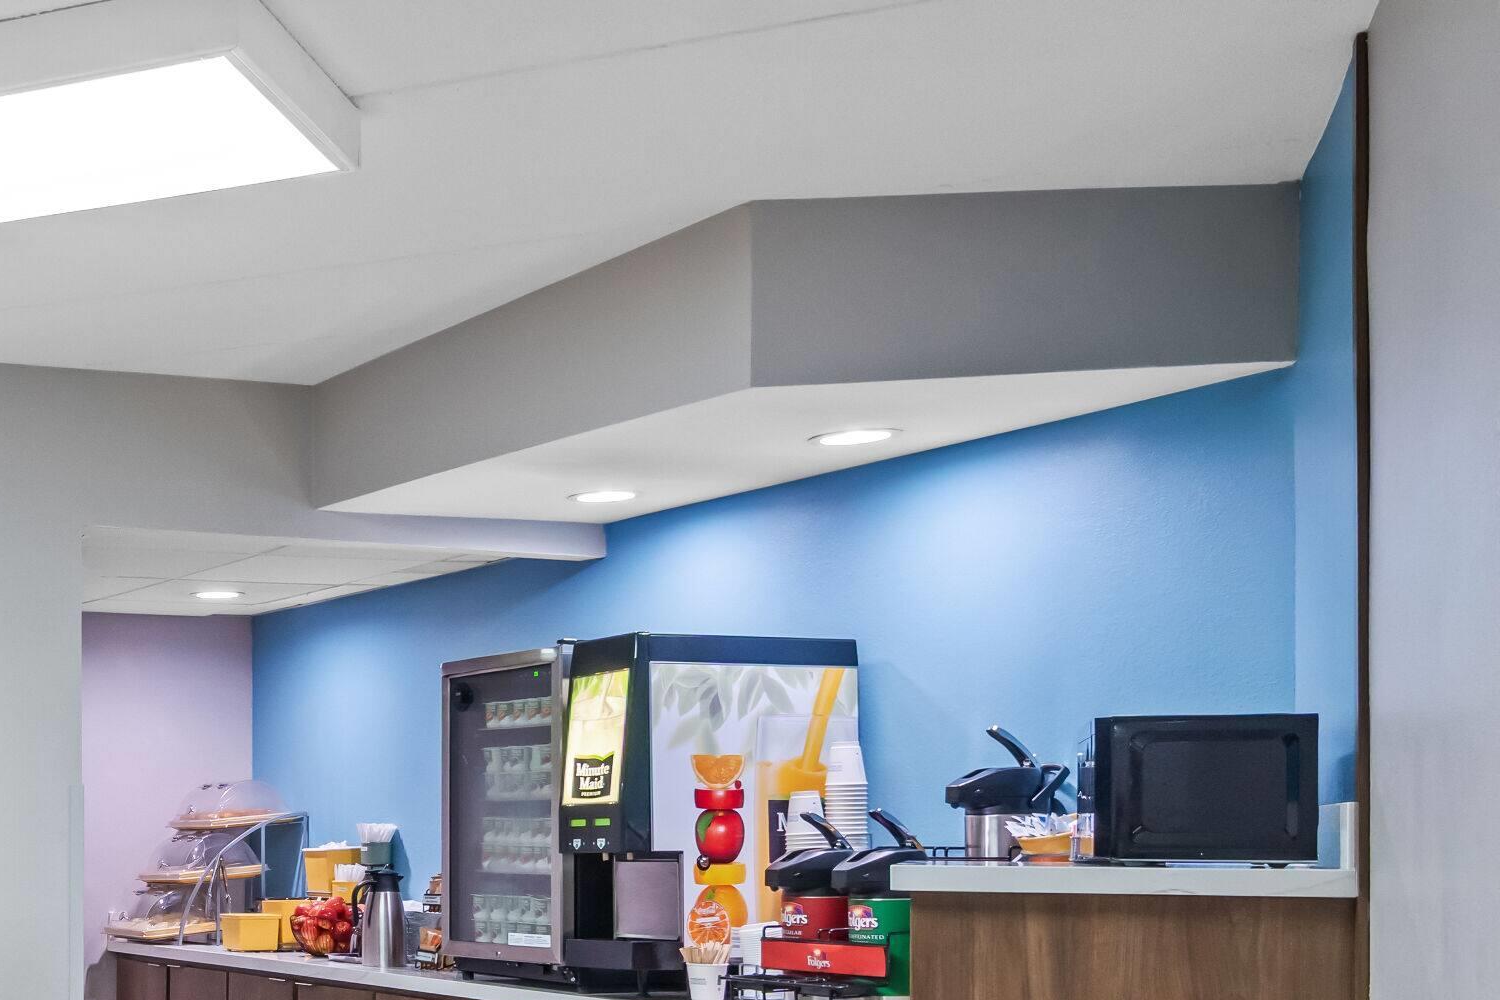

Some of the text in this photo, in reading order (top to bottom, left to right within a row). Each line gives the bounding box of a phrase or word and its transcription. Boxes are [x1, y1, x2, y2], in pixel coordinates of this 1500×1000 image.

[576, 762, 610, 776] Minute
[579, 776, 604, 789] Maid
[807, 956, 831, 969] Folgers
